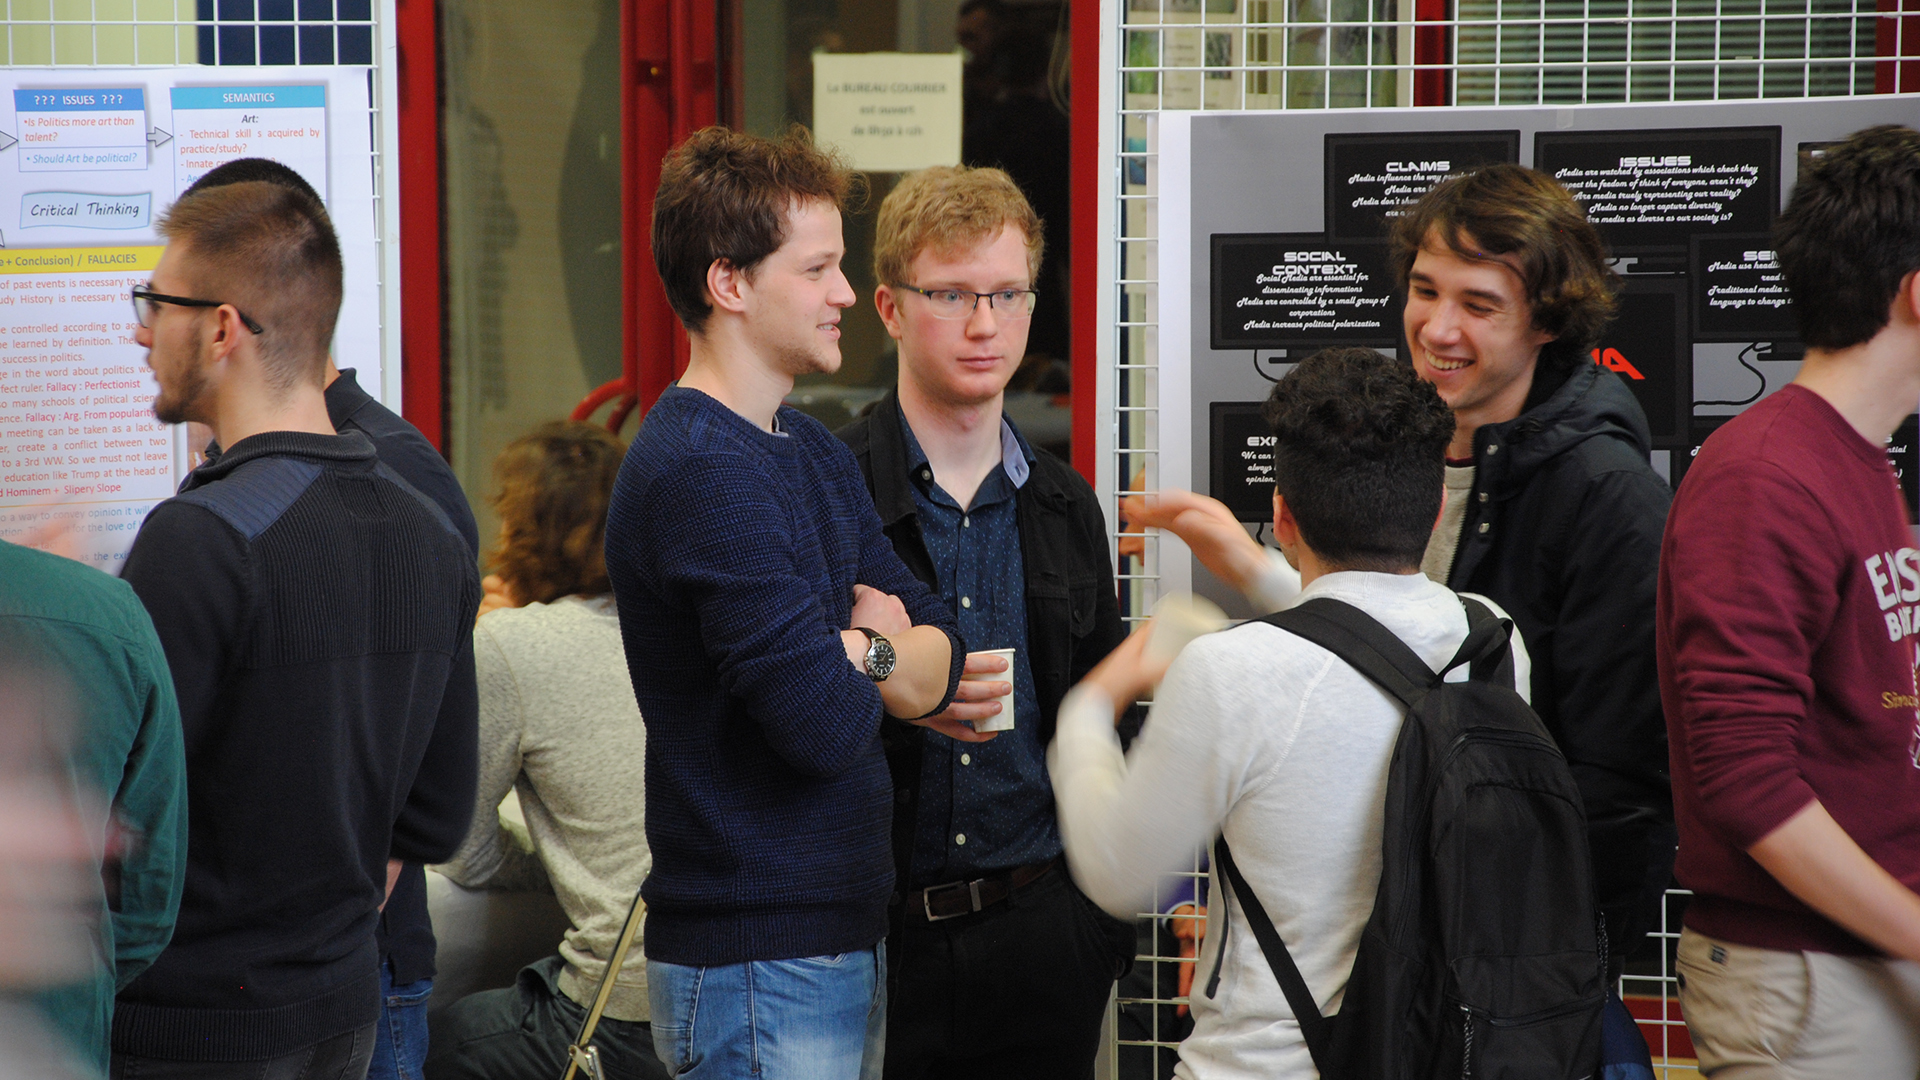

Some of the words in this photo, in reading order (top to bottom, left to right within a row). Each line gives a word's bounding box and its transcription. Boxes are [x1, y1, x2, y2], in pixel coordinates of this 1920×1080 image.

[63, 95, 95, 105] ISSUES
[223, 93, 275, 102] SEMANTICS
[38, 118, 70, 126] Politics
[114, 117, 134, 125] than
[190, 130, 229, 138] Technical
[235, 129, 251, 138] skill
[268, 128, 303, 138] acquired
[310, 128, 320, 138] by
[33, 154, 64, 163] Should
[66, 154, 80, 163] Art
[83, 154, 94, 162] be
[186, 160, 213, 168] Innate
[1620, 156, 1691, 167] ISSUES
[1386, 161, 1450, 172] CLAIMS
[1555, 168, 1583, 178] Media
[1600, 167, 1632, 175] watched
[1692, 165, 1715, 173] which
[1717, 164, 1739, 172] check
[1741, 164, 1758, 175] they
[1348, 174, 1375, 184] Media
[1377, 173, 1411, 184] influence
[1585, 180, 1597, 188] the
[1599, 179, 1627, 190] feedom
[1639, 178, 1660, 186] think
[1385, 185, 1412, 195] Media
[1352, 197, 1379, 207] Media
[1593, 191, 1617, 199] media
[1618, 191, 1642, 202] truely
[1644, 191, 1693, 201] representing
[31, 203, 78, 216] Critical
[86, 202, 139, 217] Thinking
[1589, 203, 1617, 213] Media
[1630, 203, 1655, 213] longer
[1657, 204, 1687, 213] capture
[1688, 201, 1722, 212] diversity
[1601, 215, 1625, 223] media
[1637, 214, 1664, 222] diverse
[1693, 214, 1719, 224] society
[88, 254, 137, 264] FALLACIES
[1284, 251, 1346, 262] SOCIAL
[1272, 264, 1357, 275] CONTEXT
[1708, 261, 1736, 272] Media
[1256, 274, 1280, 284] Social
[1281, 273, 1307, 284] Media
[1323, 273, 1356, 282] essential
[1356, 273, 1369, 283] for
[1761, 273, 1781, 281] read
[1, 280, 10, 289] of
[14, 280, 32, 290] past
[36, 280, 65, 288] events
[69, 279, 76, 287] is
[80, 279, 123, 288] necessary
[1262, 286, 1313, 296] disseminating
[1314, 285, 1362, 295] informations
[1708, 285, 1758, 296] Traditional
[1758, 285, 1782, 293] media
[21, 295, 53, 304] History
[71, 294, 115, 303] necessary
[1237, 297, 1264, 307] Media
[1279, 297, 1316, 305] controlled
[1335, 296, 1354, 304] small
[1355, 299, 1378, 307] group
[1710, 298, 1746, 309] language
[1757, 297, 1785, 308] change
[1289, 309, 1335, 319] corporations
[11, 324, 58, 334] controlled
[63, 323, 106, 332] according
[1244, 321, 1270, 330] Media
[1303, 320, 1334, 331] political
[1334, 320, 1380, 330] polarization
[13, 339, 47, 348] learned
[2, 355, 37, 363] success
[26, 369, 40, 378] the
[45, 368, 68, 377] word
[73, 367, 98, 376] about
[103, 366, 134, 376] politics
[47, 383, 76, 392] Fallacy
[85, 380, 140, 390] Perfectionist
[13, 400, 37, 409] many
[42, 397, 75, 407] schools
[94, 395, 128, 405] political
[26, 413, 55, 422] Fallacy
[84, 411, 107, 419] From
[7, 428, 43, 438] meeting
[84, 425, 108, 434] taken
[136, 423, 153, 432] lack
[17, 444, 45, 452] create
[64, 441, 97, 450] conflict
[104, 438, 142, 448] between
[25, 457, 39, 466] 3rd
[100, 455, 122, 463] must
[145, 452, 167, 460] leave
[5, 472, 49, 483] education
[53, 471, 68, 479] like
[72, 470, 100, 479] Trump
[116, 468, 130, 476] the
[134, 466, 155, 476] head
[1248, 464, 1272, 474] always
[7, 488, 50, 497] Hominem
[64, 484, 94, 495] Slipery
[97, 483, 121, 493] Slope
[89, 508, 122, 518] opinion
[106, 522, 124, 531] love
